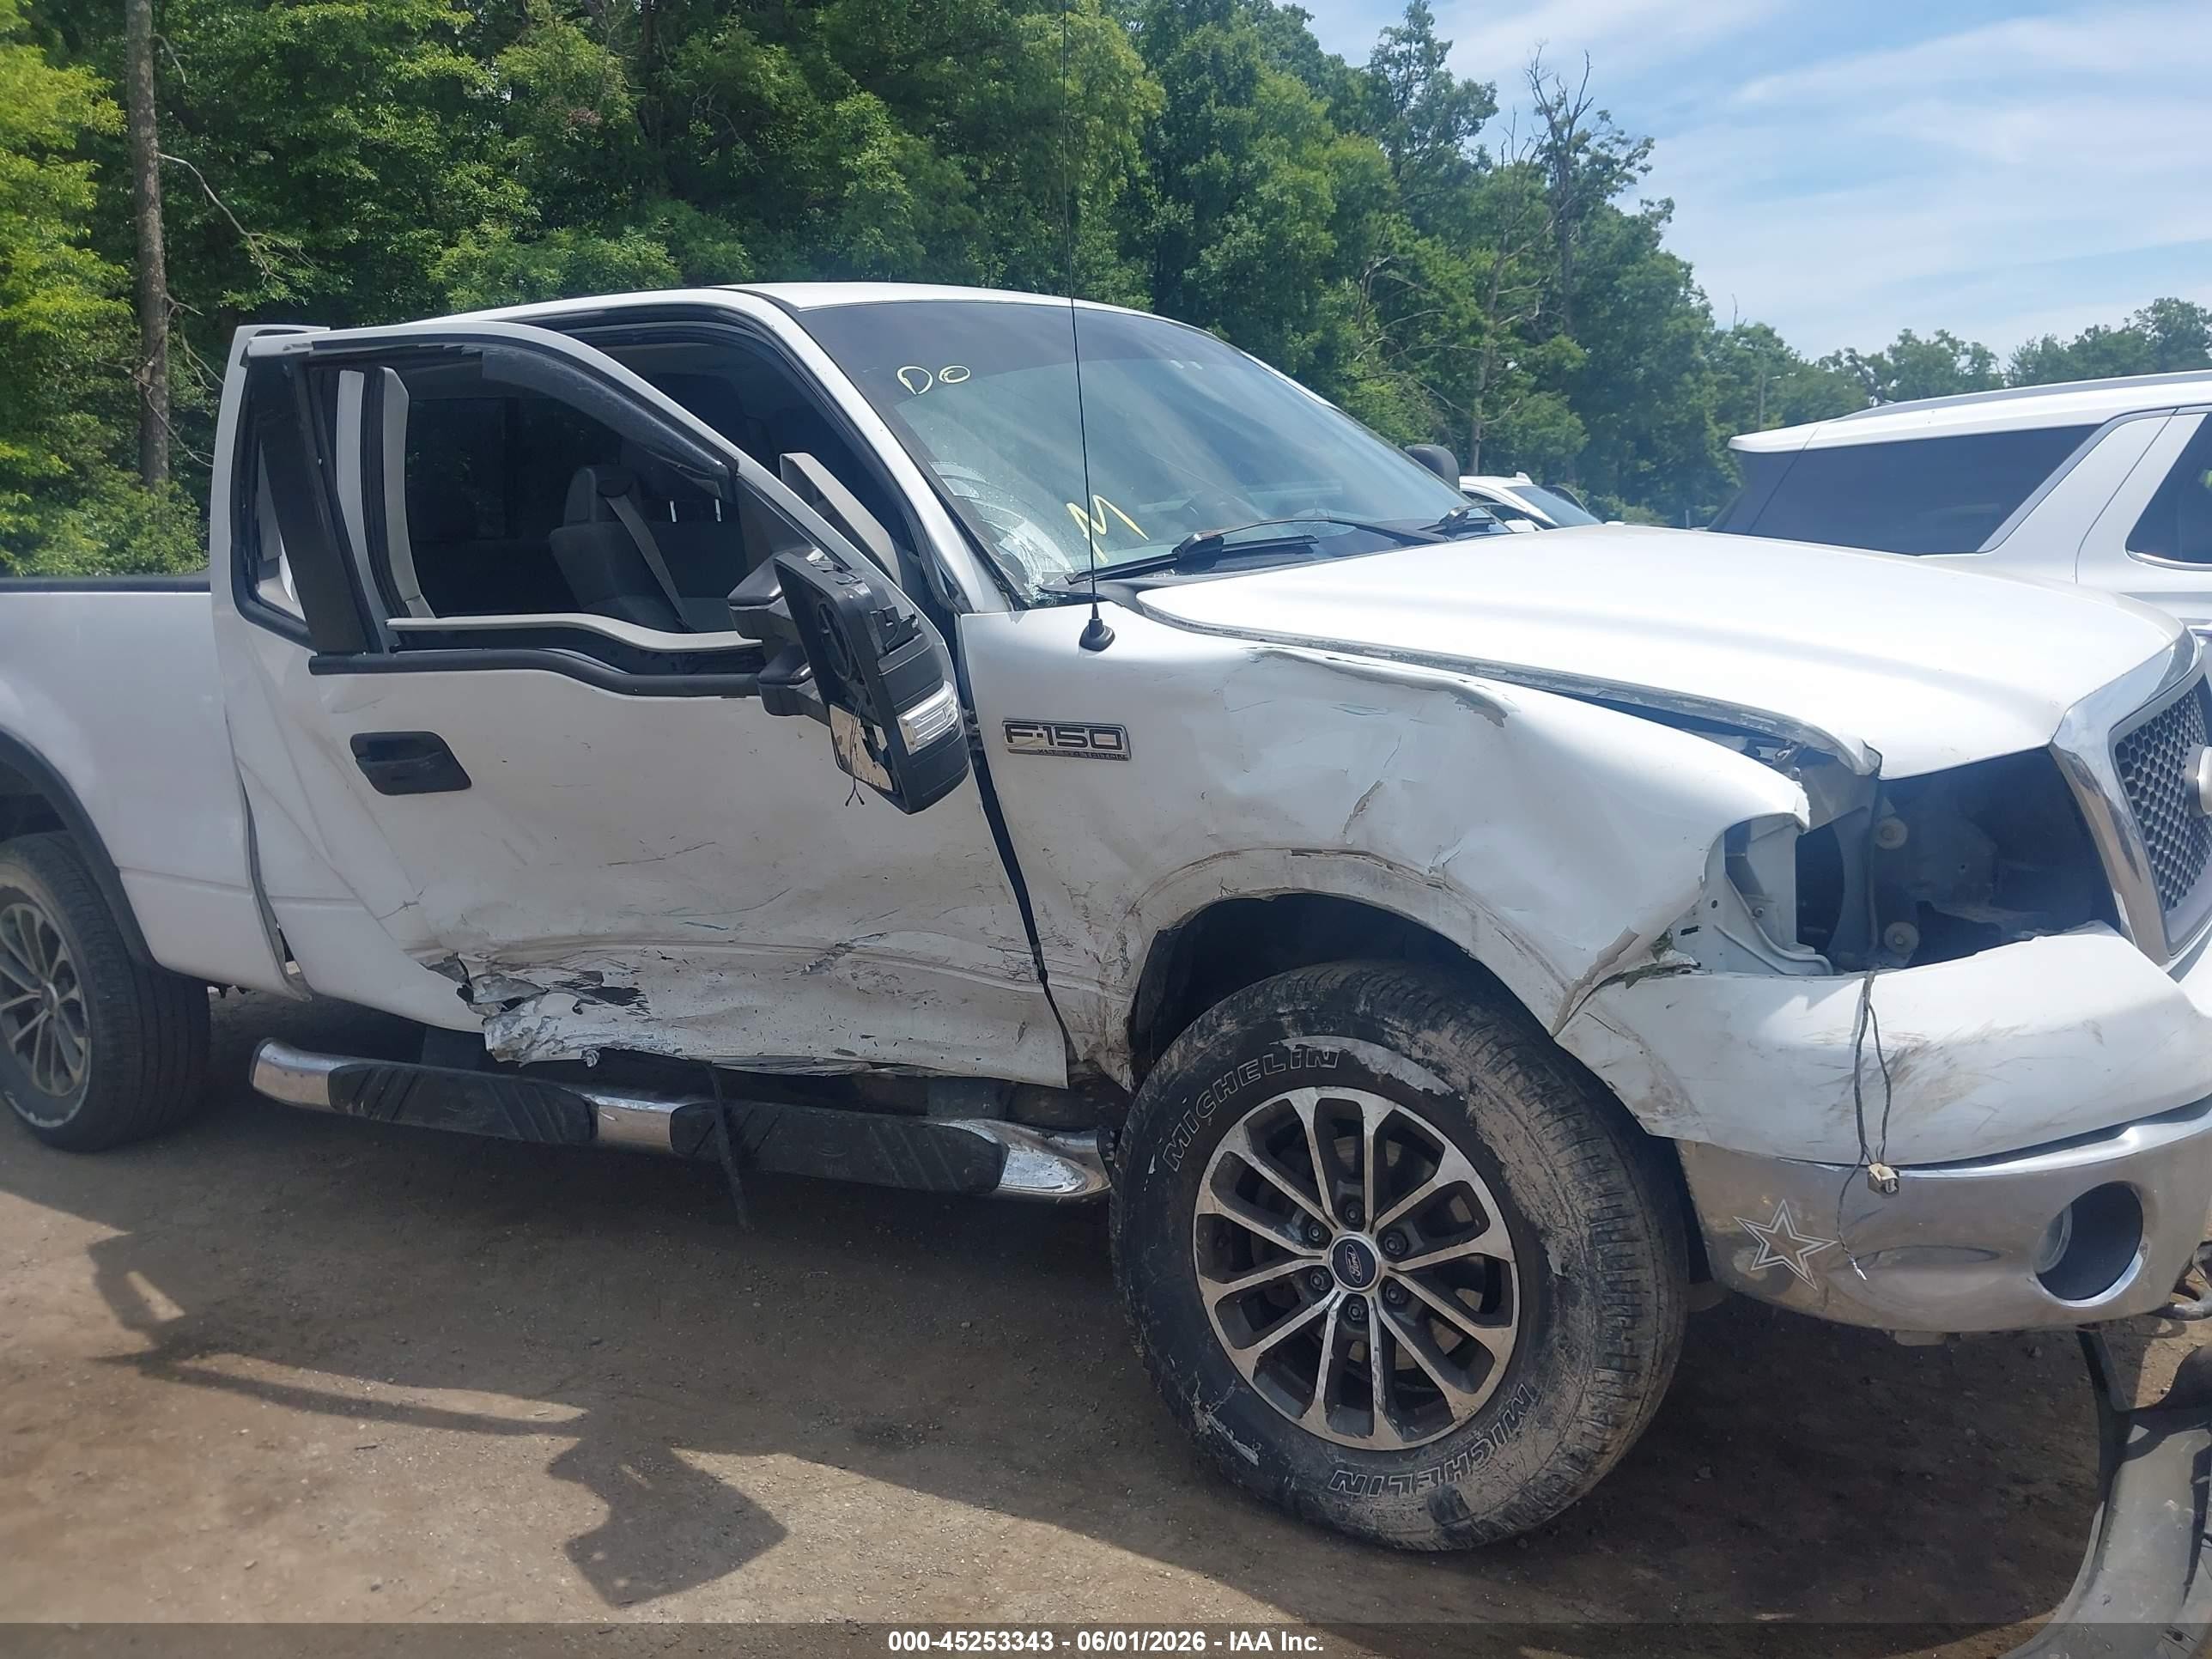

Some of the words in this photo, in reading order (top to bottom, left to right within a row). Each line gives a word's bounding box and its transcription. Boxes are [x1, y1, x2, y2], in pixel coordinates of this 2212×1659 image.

[1005, 724, 1123, 750] F-150
[1162, 1047, 1340, 1172] MICHELIN
[1328, 1382, 1541, 1497] MICHELIN
